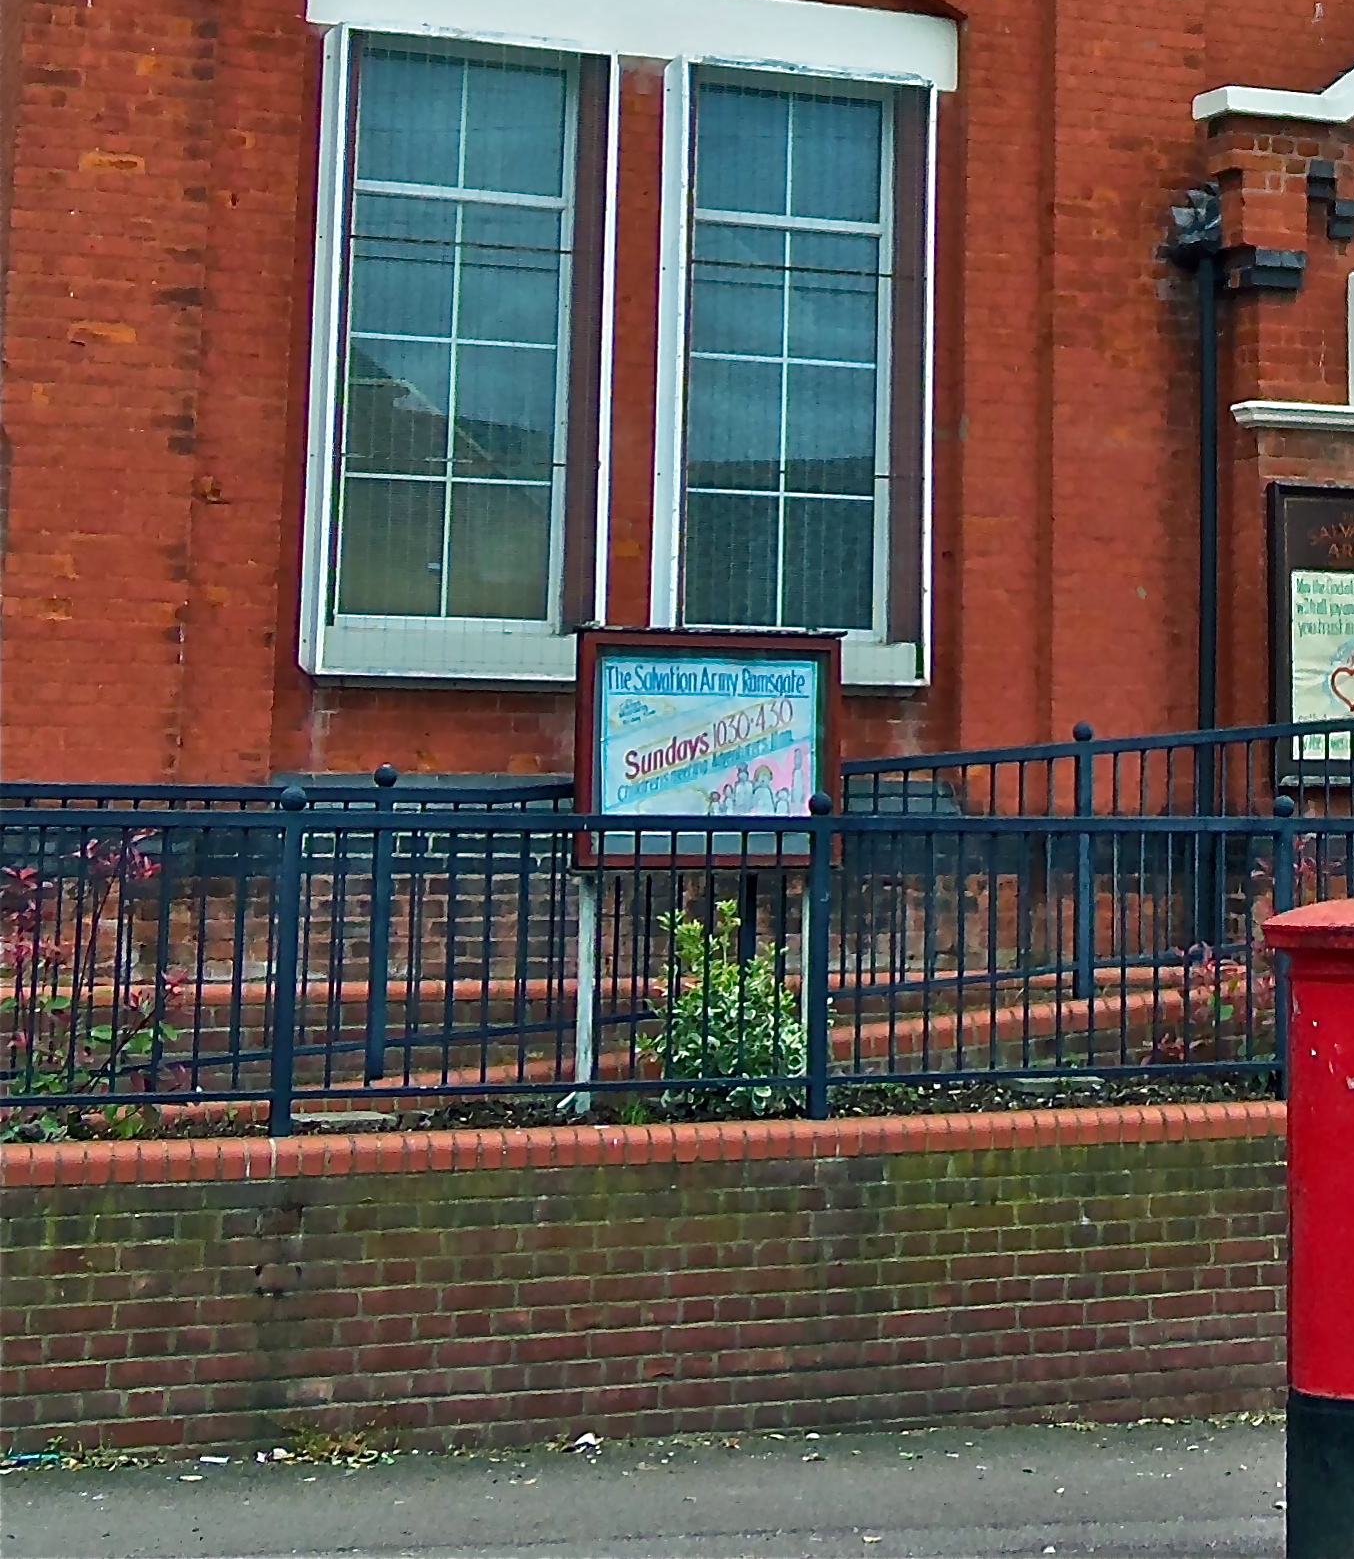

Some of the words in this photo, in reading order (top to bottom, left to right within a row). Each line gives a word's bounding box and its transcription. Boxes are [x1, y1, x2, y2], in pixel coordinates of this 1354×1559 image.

[606, 665, 632, 691] The
[633, 664, 698, 692] Salvation
[700, 666, 739, 696] Army
[742, 667, 806, 695] Ramsgate
[624, 732, 710, 780] Sundays
